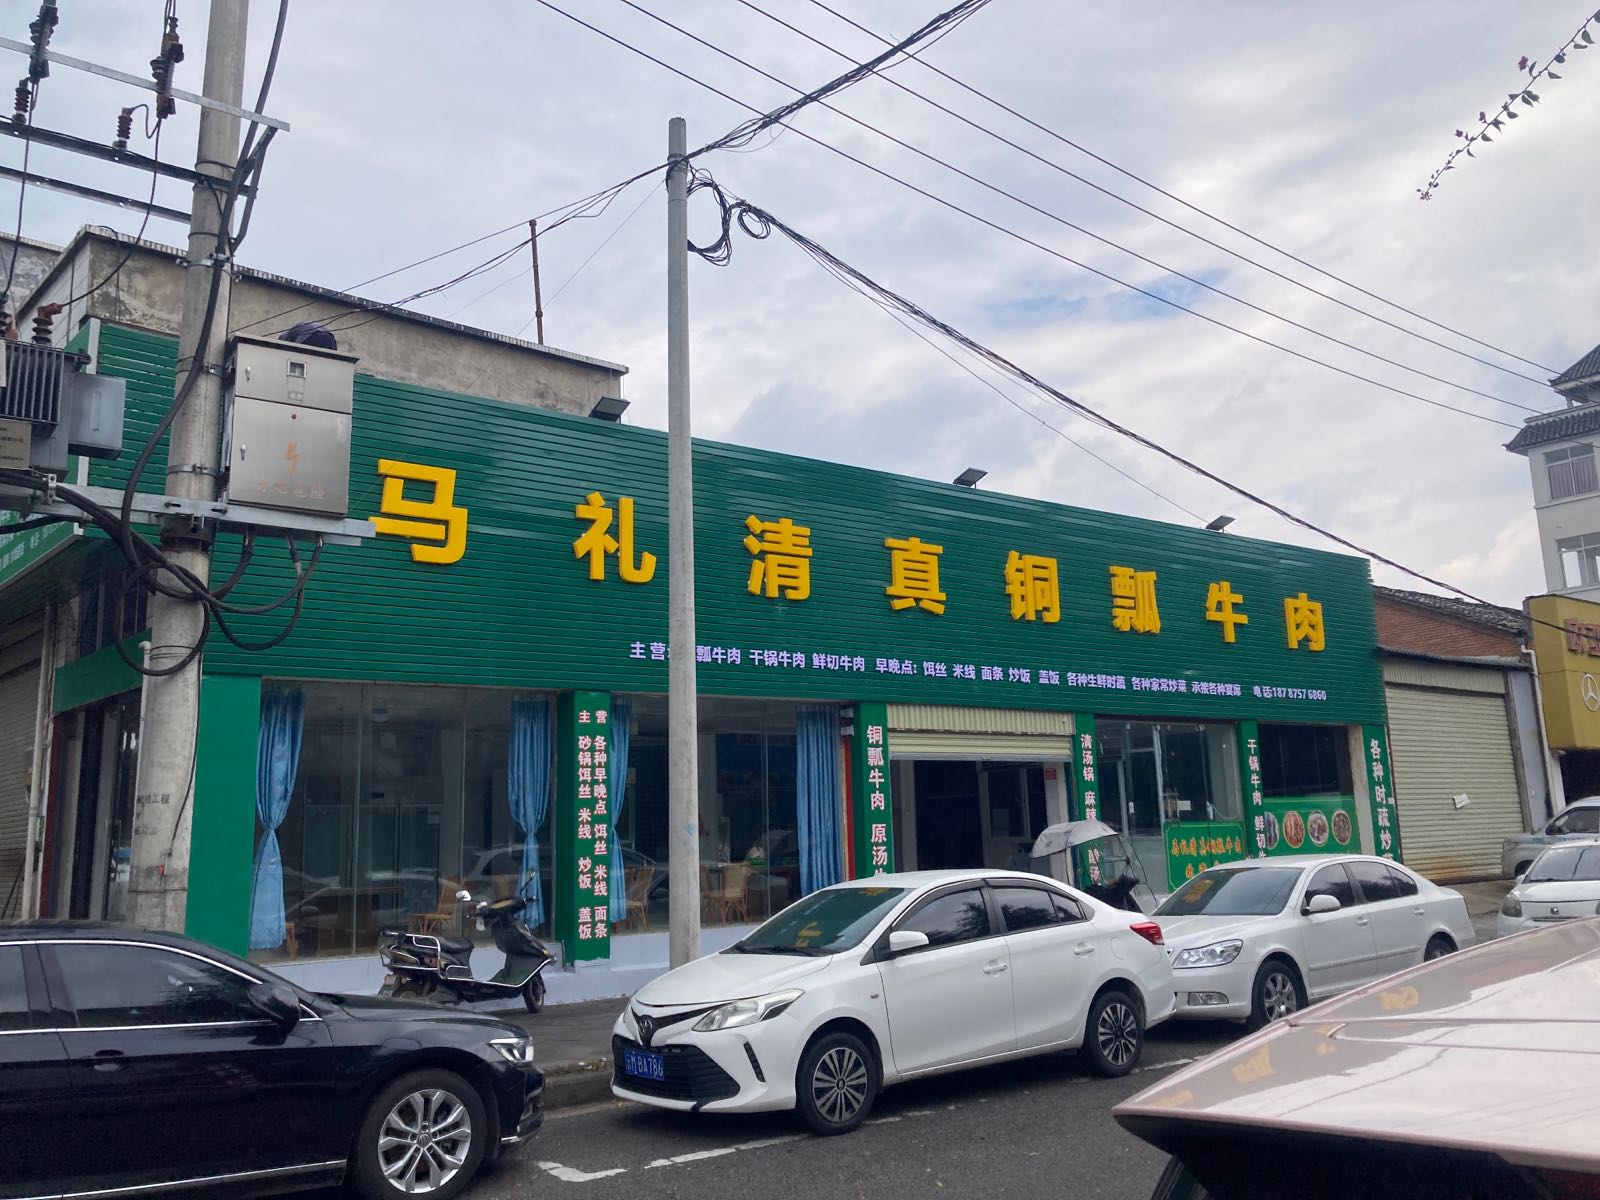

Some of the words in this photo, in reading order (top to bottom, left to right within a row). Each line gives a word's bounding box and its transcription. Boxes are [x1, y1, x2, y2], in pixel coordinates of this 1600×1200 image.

[368, 458, 1325, 651] 马礼清真铜瓢牛肉
[749, 650, 806, 668] 干锅牛肉
[812, 653, 865, 672] 鲜切牛肉
[923, 661, 948, 677] 饵丝
[952, 664, 976, 680] 米线
[981, 666, 1004, 681] 面条
[1008, 668, 1031, 684] 炒饭
[1038, 670, 1060, 685] 盖饭
[1131, 676, 1187, 693] 各种家常炒菜
[578, 735, 592, 799] 砂锅饵丝
[594, 735, 607, 815] 各种早晚点
[867, 725, 885, 810] 铜瓢牛肉
[1081, 733, 1095, 782] 清汤锅
[1247, 739, 1261, 805] 干锅牛肉
[578, 808, 592, 839] 米线
[594, 823, 607, 855] 饵丝
[578, 857, 592, 889] 炒饭
[594, 865, 607, 896] 米线
[578, 907, 592, 939] 盖饭
[594, 906, 607, 938] 面条
